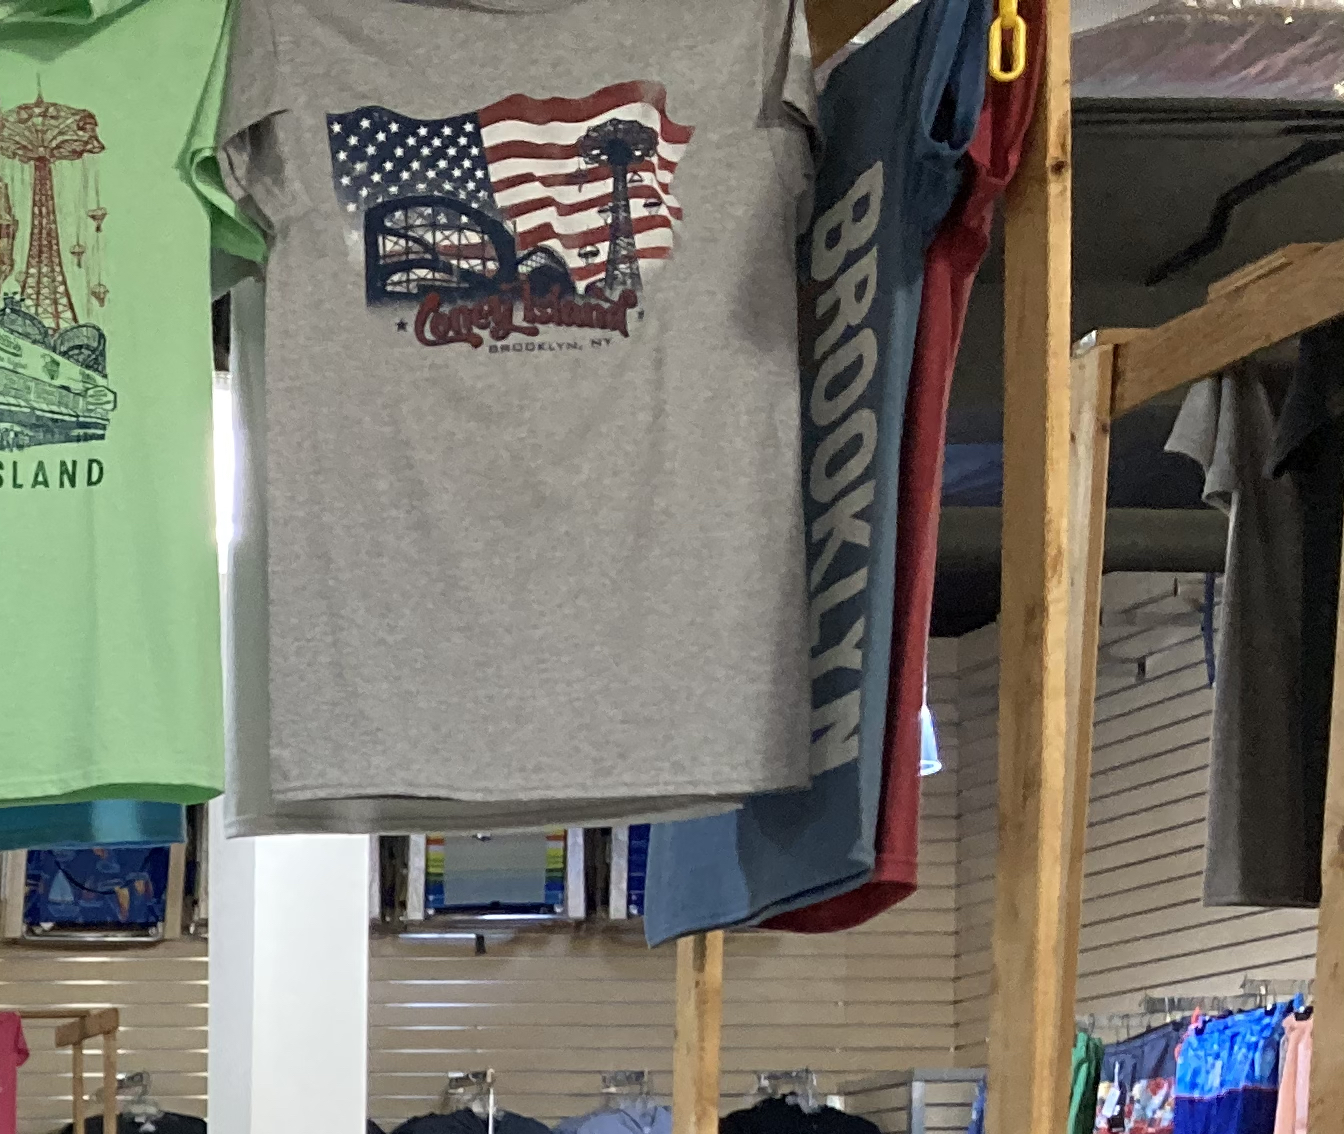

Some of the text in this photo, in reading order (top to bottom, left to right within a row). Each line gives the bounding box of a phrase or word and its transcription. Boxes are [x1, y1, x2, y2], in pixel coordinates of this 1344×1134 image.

[415, 291, 540, 348] Coney
[591, 338, 611, 349] NY
[809, 160, 886, 783] BROOKLYN
